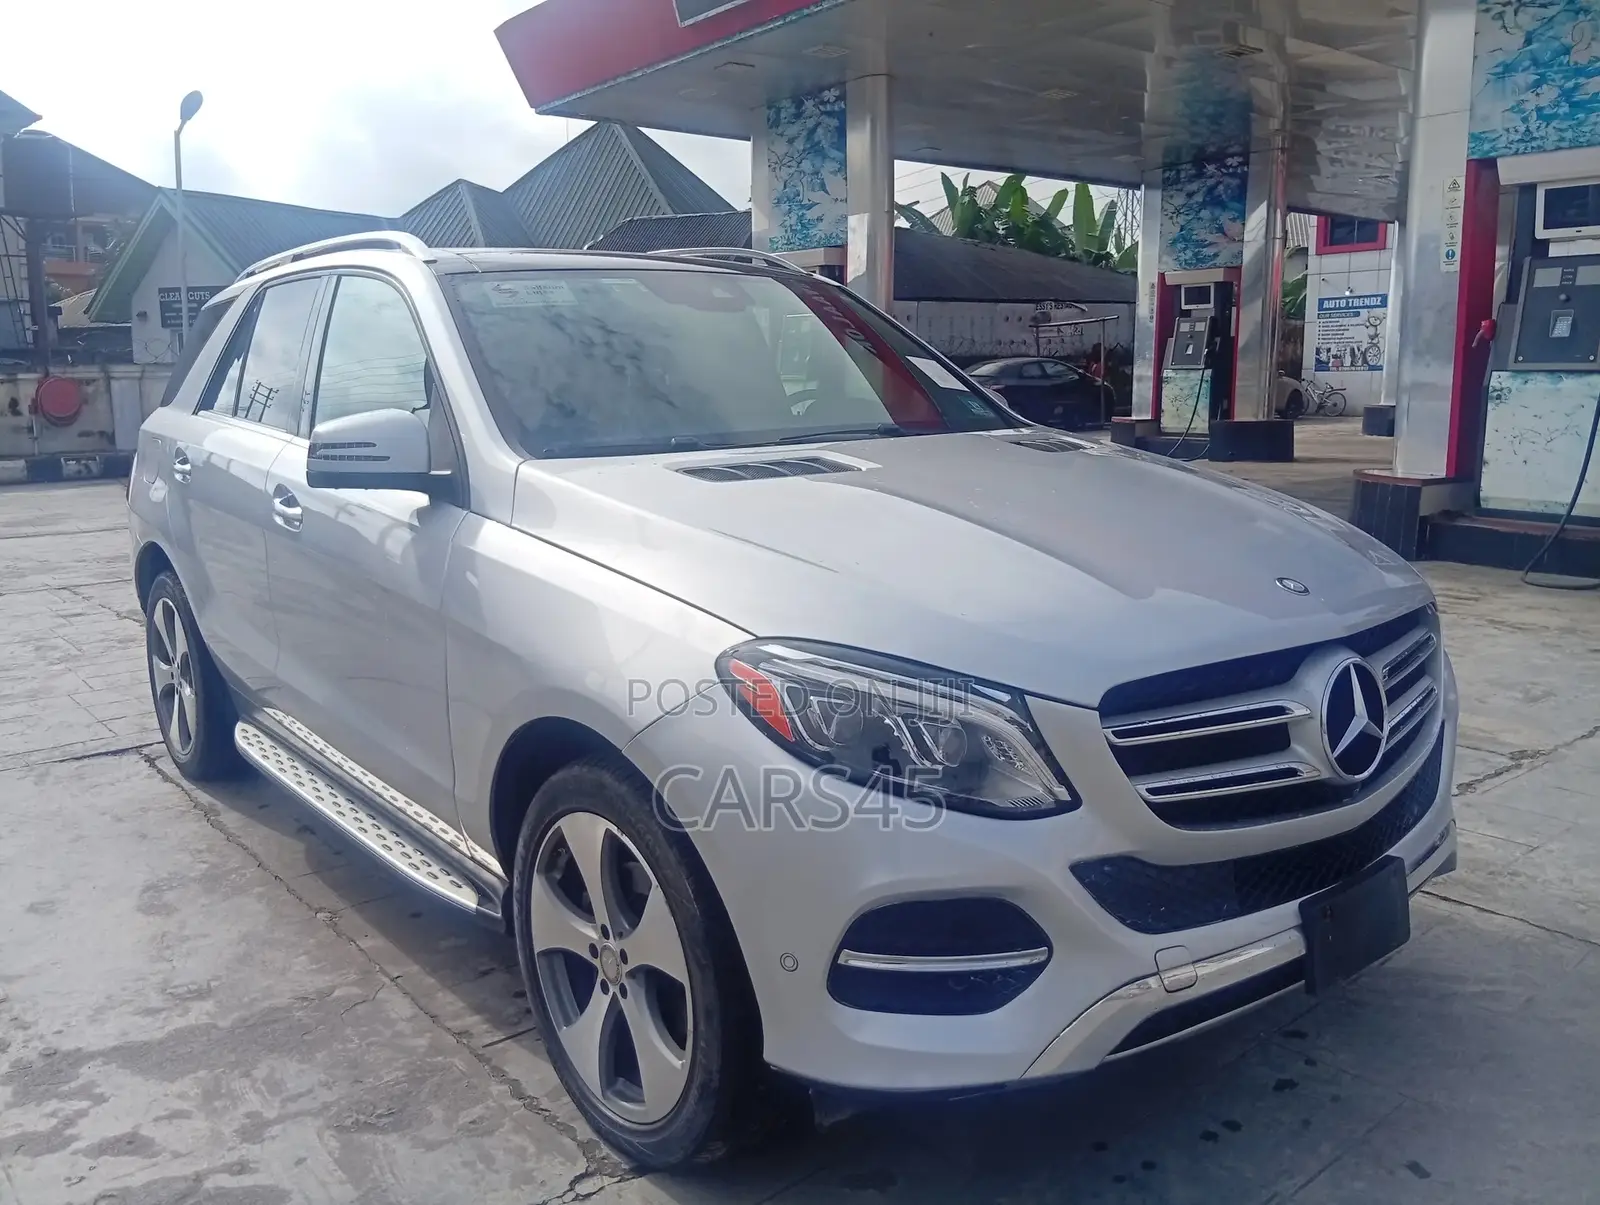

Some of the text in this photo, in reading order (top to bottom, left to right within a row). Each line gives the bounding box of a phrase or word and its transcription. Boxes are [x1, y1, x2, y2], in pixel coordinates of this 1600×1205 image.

[160, 291, 210, 301] CLEA CUTS
[1323, 296, 1382, 309] AUTO TRENDZ
